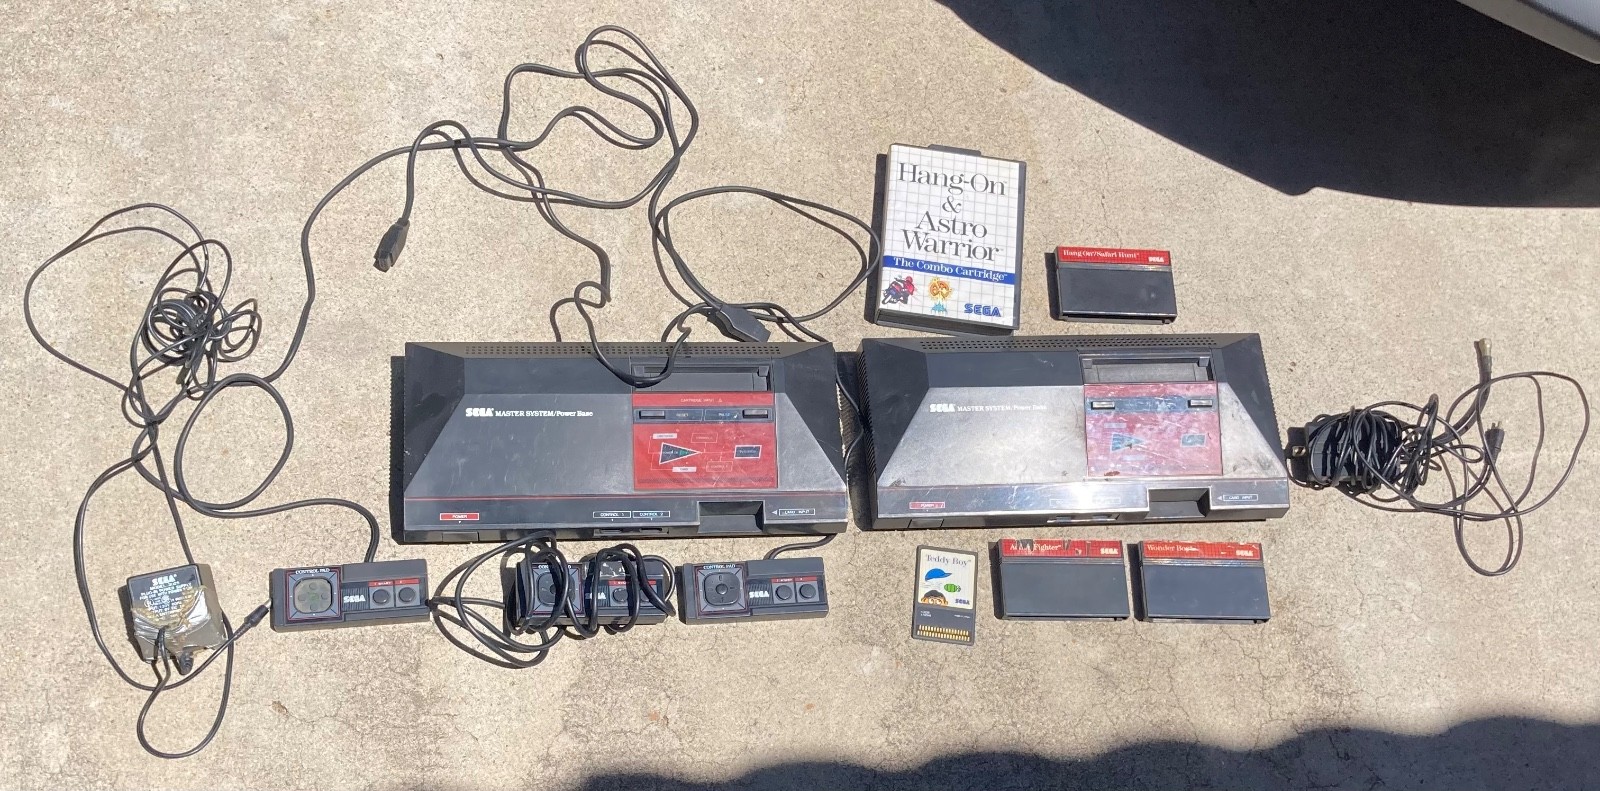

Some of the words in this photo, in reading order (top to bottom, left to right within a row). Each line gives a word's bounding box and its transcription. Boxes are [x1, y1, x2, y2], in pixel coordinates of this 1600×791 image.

[898, 162, 1005, 195] Hang-On
[941, 195, 962, 214] &
[915, 210, 988, 238] Astro
[901, 228, 1000, 261] Warrior
[1063, 249, 1082, 257] Hang
[1118, 251, 1136, 259] Hunt
[893, 256, 915, 268] The
[916, 259, 953, 274] Combo
[955, 266, 1005, 282] Cartridge
[964, 303, 1001, 317] SEGA
[465, 407, 494, 417] SEGA
[929, 403, 955, 413] SEGA
[1033, 543, 1058, 552] Fighter
[1100, 547, 1119, 555] SEGA
[925, 554, 950, 566] Teddy
[952, 557, 968, 567] Boy
[152, 574, 176, 587] SEGA
[343, 595, 366, 604] SEGA
[749, 590, 770, 598] SEGA
[954, 598, 970, 606] SEGA
